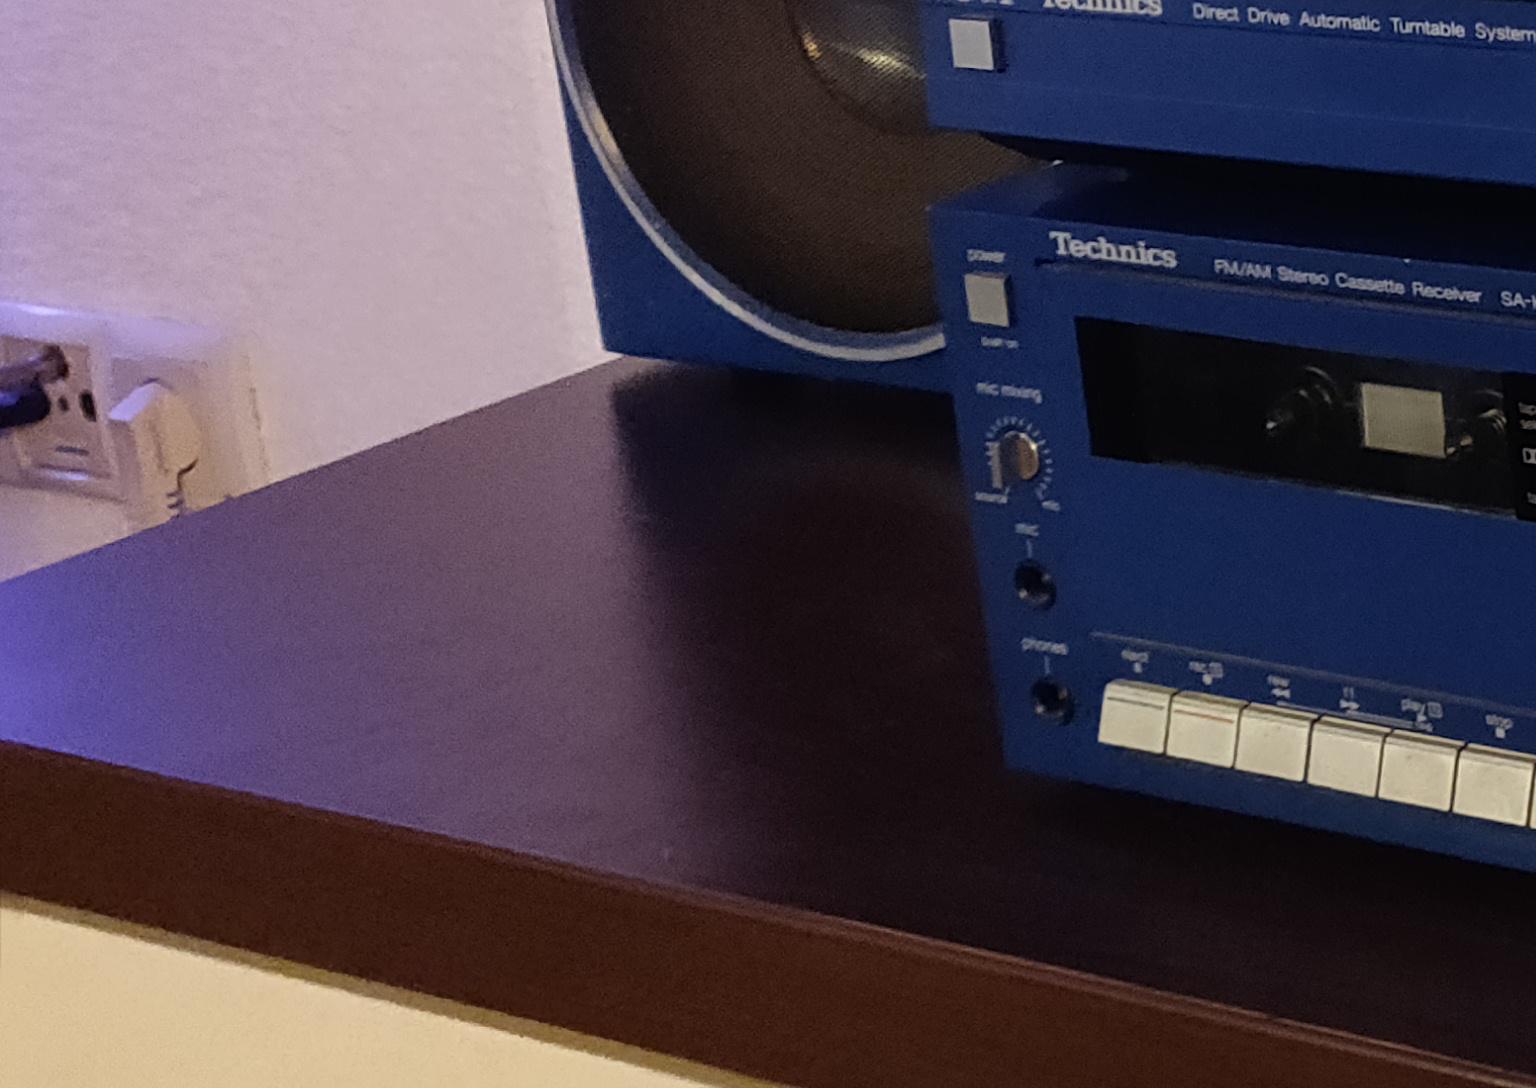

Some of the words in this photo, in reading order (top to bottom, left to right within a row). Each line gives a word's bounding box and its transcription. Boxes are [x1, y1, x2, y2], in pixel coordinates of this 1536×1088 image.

[1192, 3, 1239, 23] Direct
[1247, 7, 1290, 26] Drive
[1299, 11, 1381, 32] Automatic
[1389, 17, 1466, 38] Turntable
[1474, 22, 1536, 43] System
[1049, 230, 1178, 269] Technics
[1214, 259, 1272, 280] FM/AM
[1276, 265, 1329, 286] Stereo
[1335, 272, 1406, 296] Cassette
[1412, 281, 1482, 304] Receiver
[1021, 637, 1069, 656] phones
